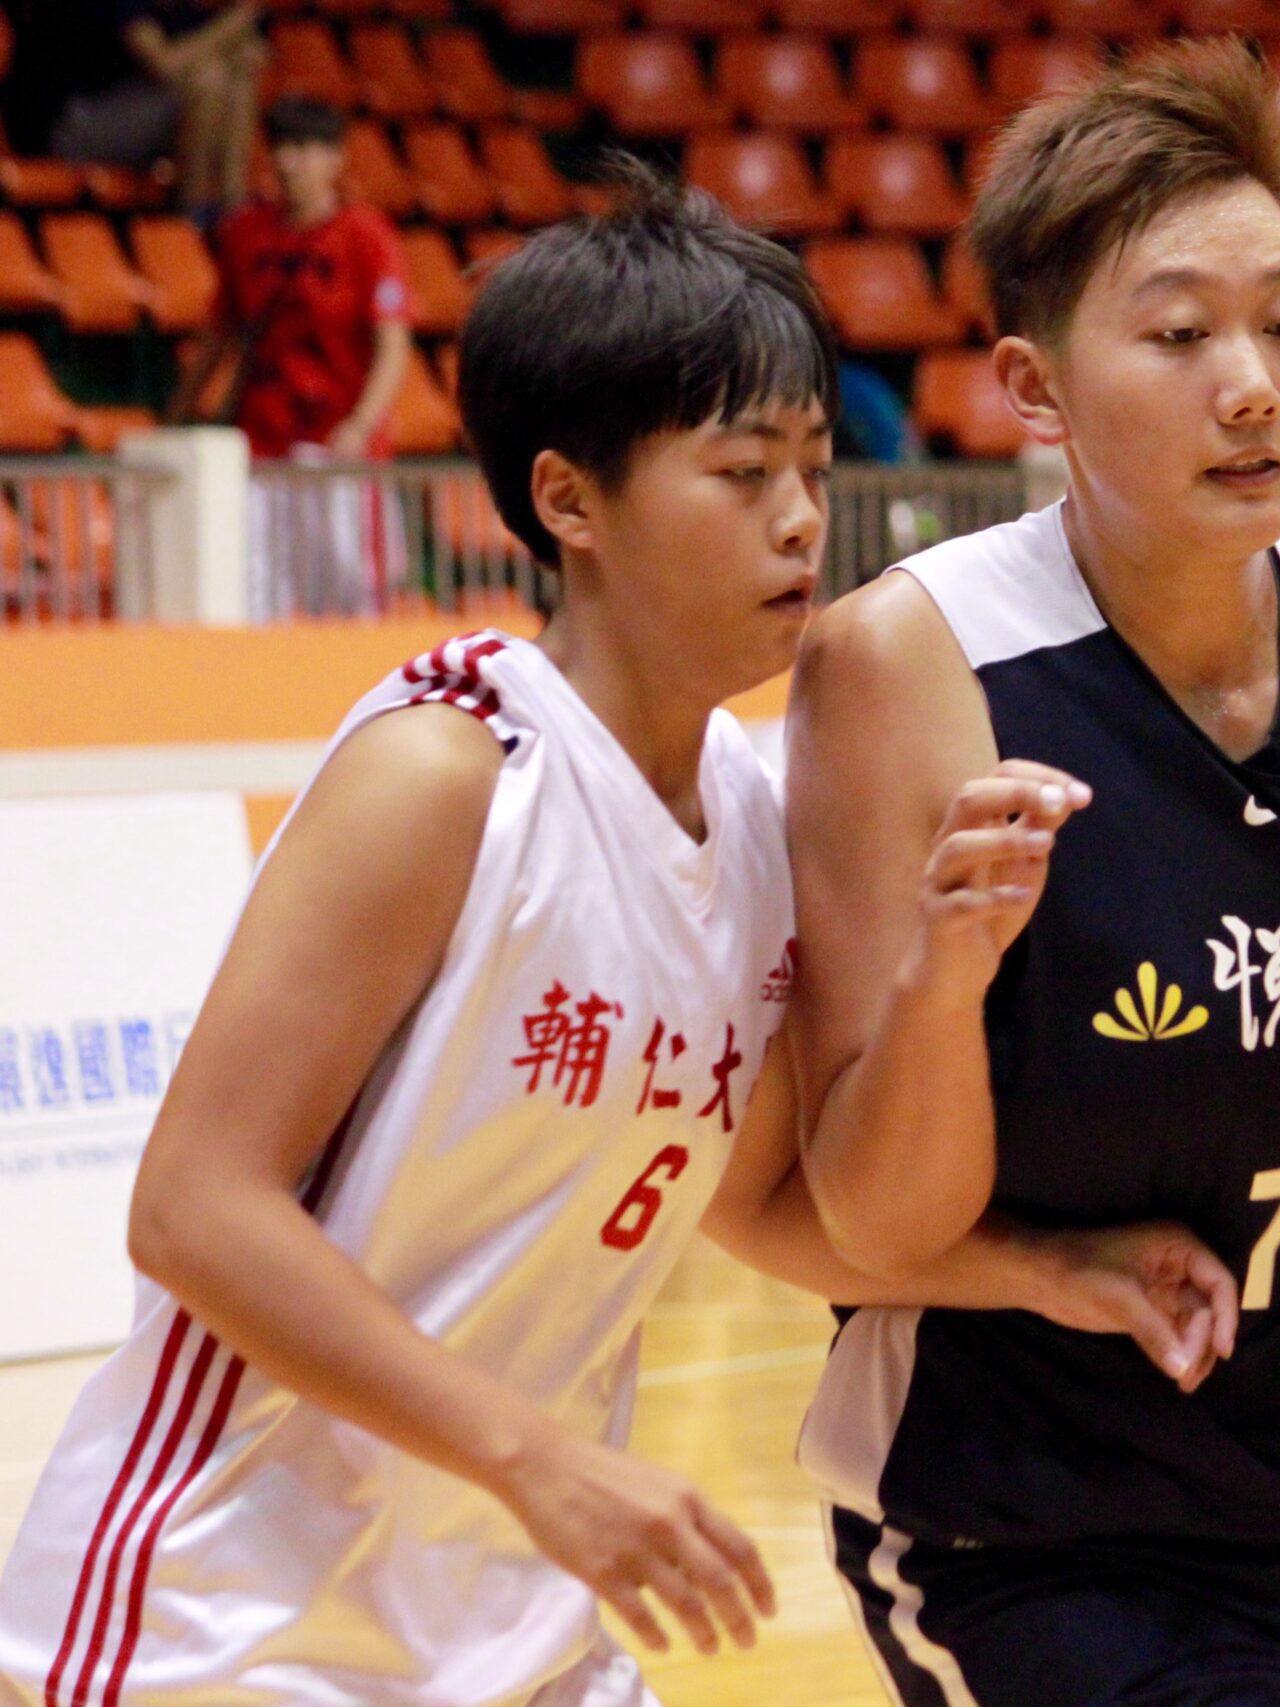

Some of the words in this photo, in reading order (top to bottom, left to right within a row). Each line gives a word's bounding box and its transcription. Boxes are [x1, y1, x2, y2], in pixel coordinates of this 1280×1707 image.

[511, 979, 768, 1134] 輔仁大
[600, 1144, 689, 1252] 6
